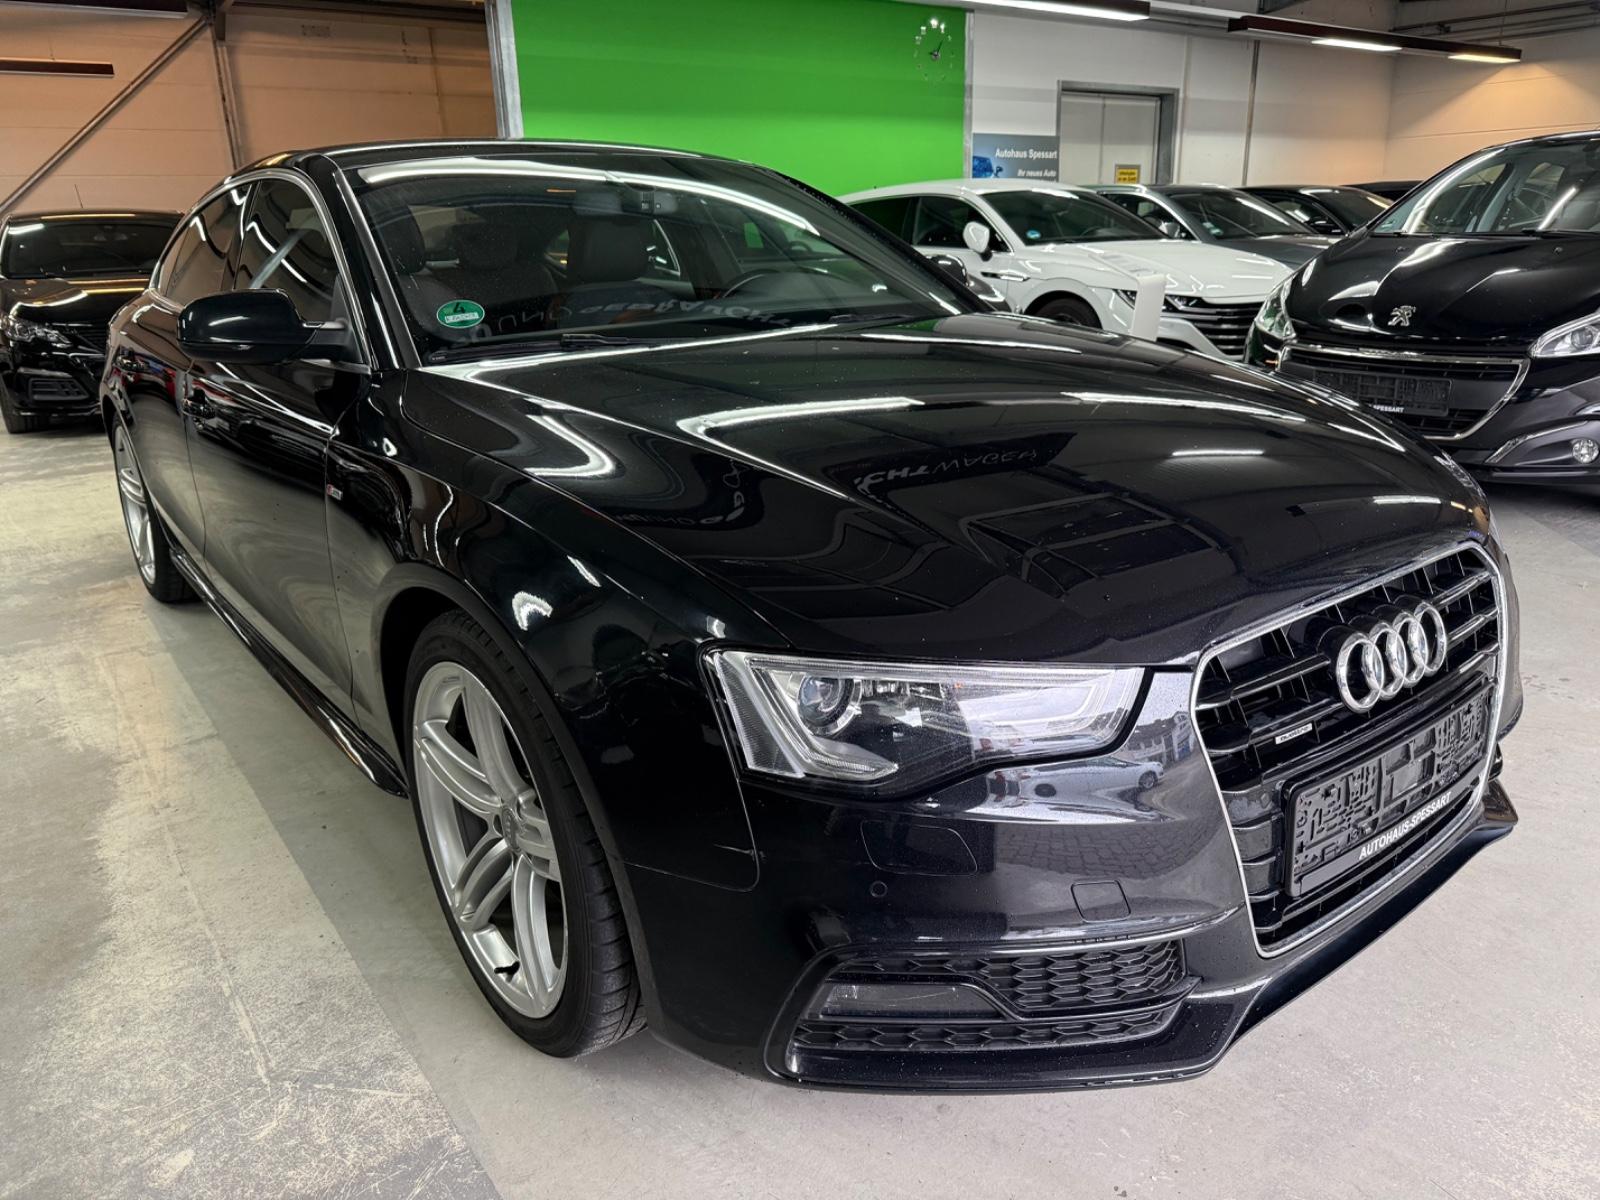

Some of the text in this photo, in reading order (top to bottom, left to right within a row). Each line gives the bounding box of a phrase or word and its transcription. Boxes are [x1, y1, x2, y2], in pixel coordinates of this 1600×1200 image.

[995, 147, 1058, 160] Autohaus Spessart
[1043, 169, 1057, 178] Auto
[1359, 791, 1452, 861] AUTOHAUS-SPESSART
